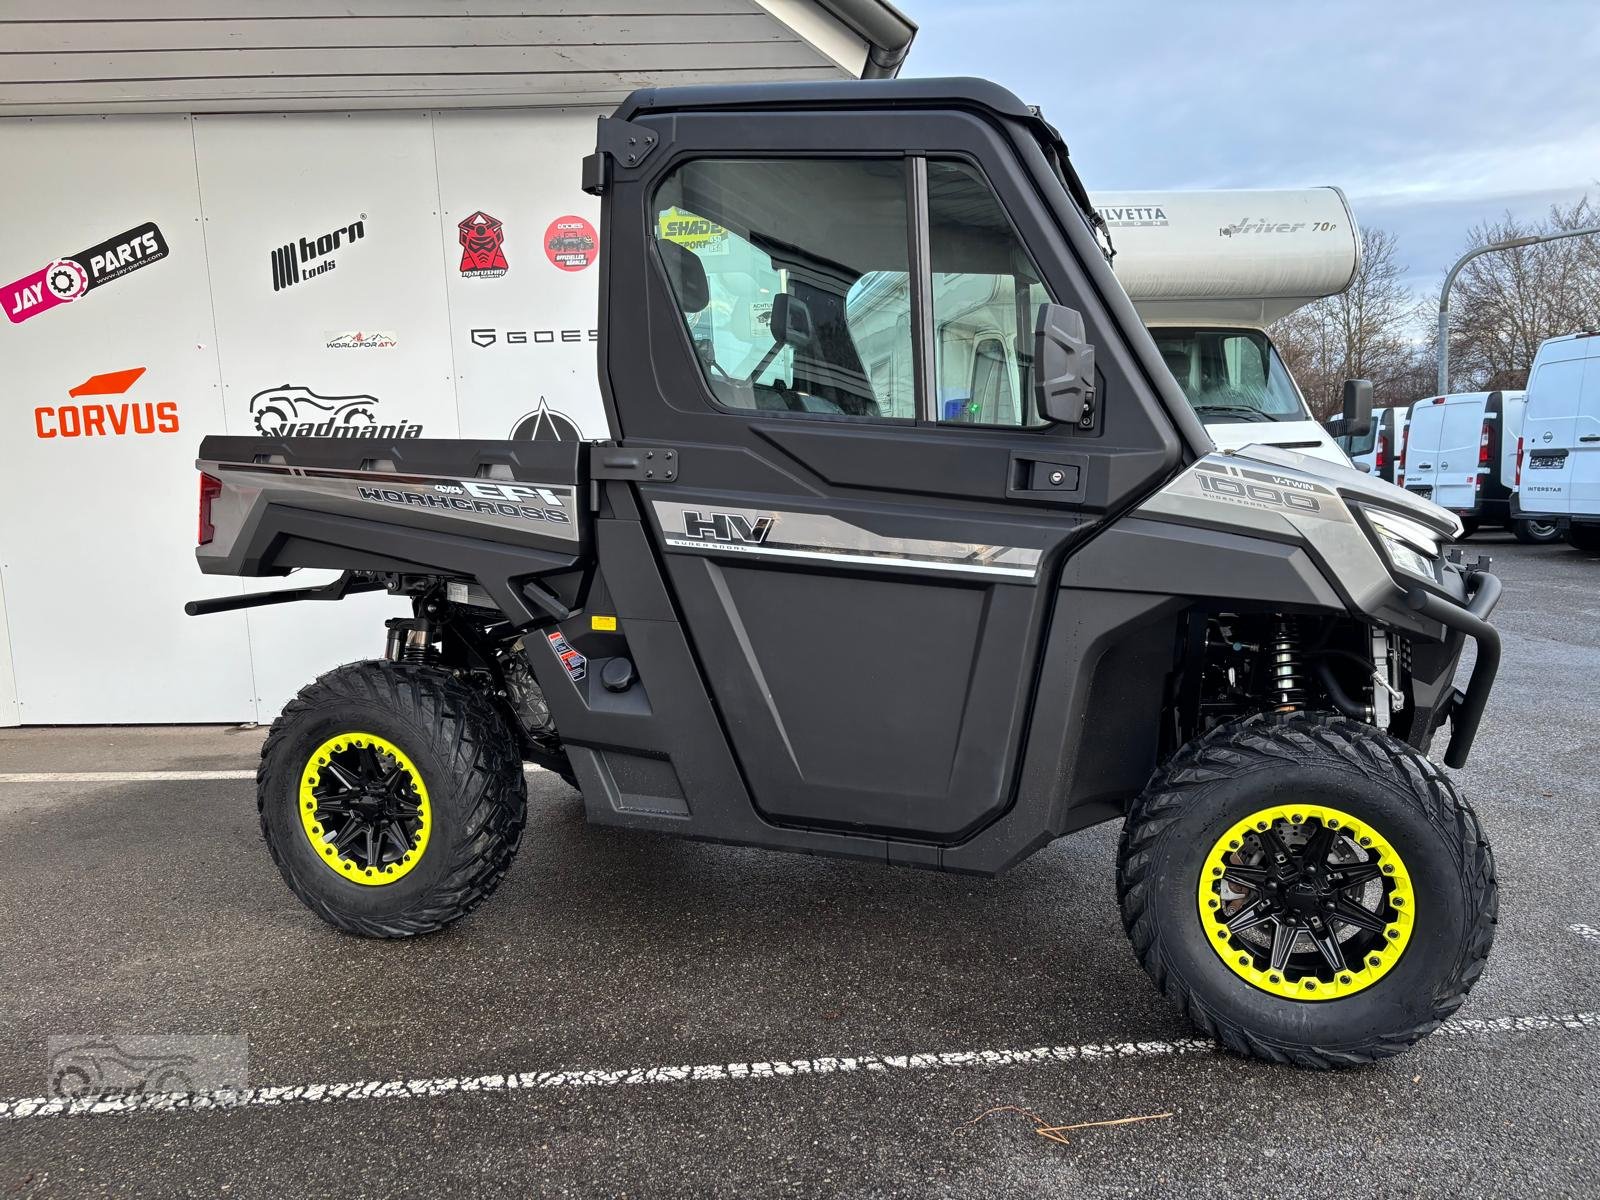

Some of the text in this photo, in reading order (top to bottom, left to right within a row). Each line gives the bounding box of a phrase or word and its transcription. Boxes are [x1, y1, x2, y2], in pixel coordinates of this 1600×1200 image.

[1098, 208, 1167, 221] ILVETTA
[299, 220, 365, 264] horn
[12, 231, 159, 315] JAY PARTS
[96, 252, 164, 284] www.jay-parts.com
[302, 260, 336, 281] tools
[34, 401, 180, 438] CORVUS
[460, 481, 565, 508] EFI
[1194, 472, 1321, 512] 1000
[1272, 476, 1315, 491] V-TWIN
[356, 484, 571, 525] WORKCROSS
[681, 509, 774, 544] HV
